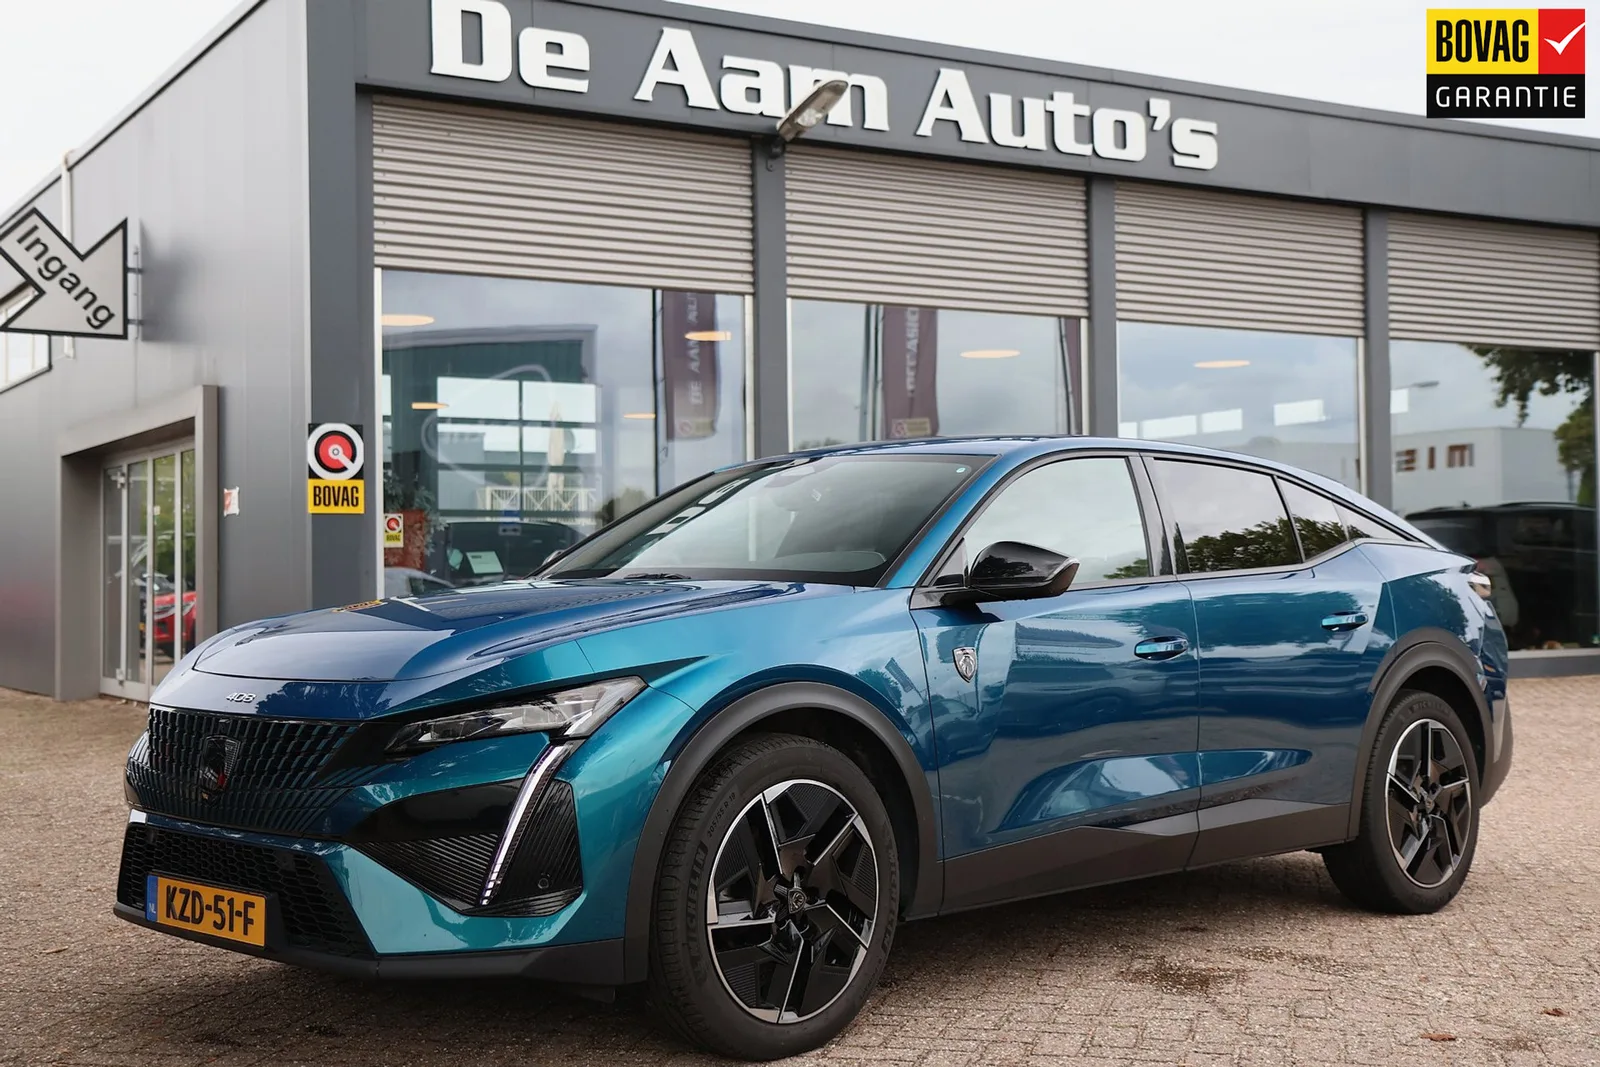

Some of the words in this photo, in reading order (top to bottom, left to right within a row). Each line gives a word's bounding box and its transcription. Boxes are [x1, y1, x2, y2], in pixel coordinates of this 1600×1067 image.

[431, 0, 590, 93] De
[634, 27, 889, 131] Aam
[916, 68, 1218, 170] Auto's
[16, 225, 115, 329] Ingang
[313, 485, 359, 508] BOVAG
[226, 692, 256, 703] 408
[149, 903, 156, 914] NL
[166, 885, 255, 936] KZD-51-F
